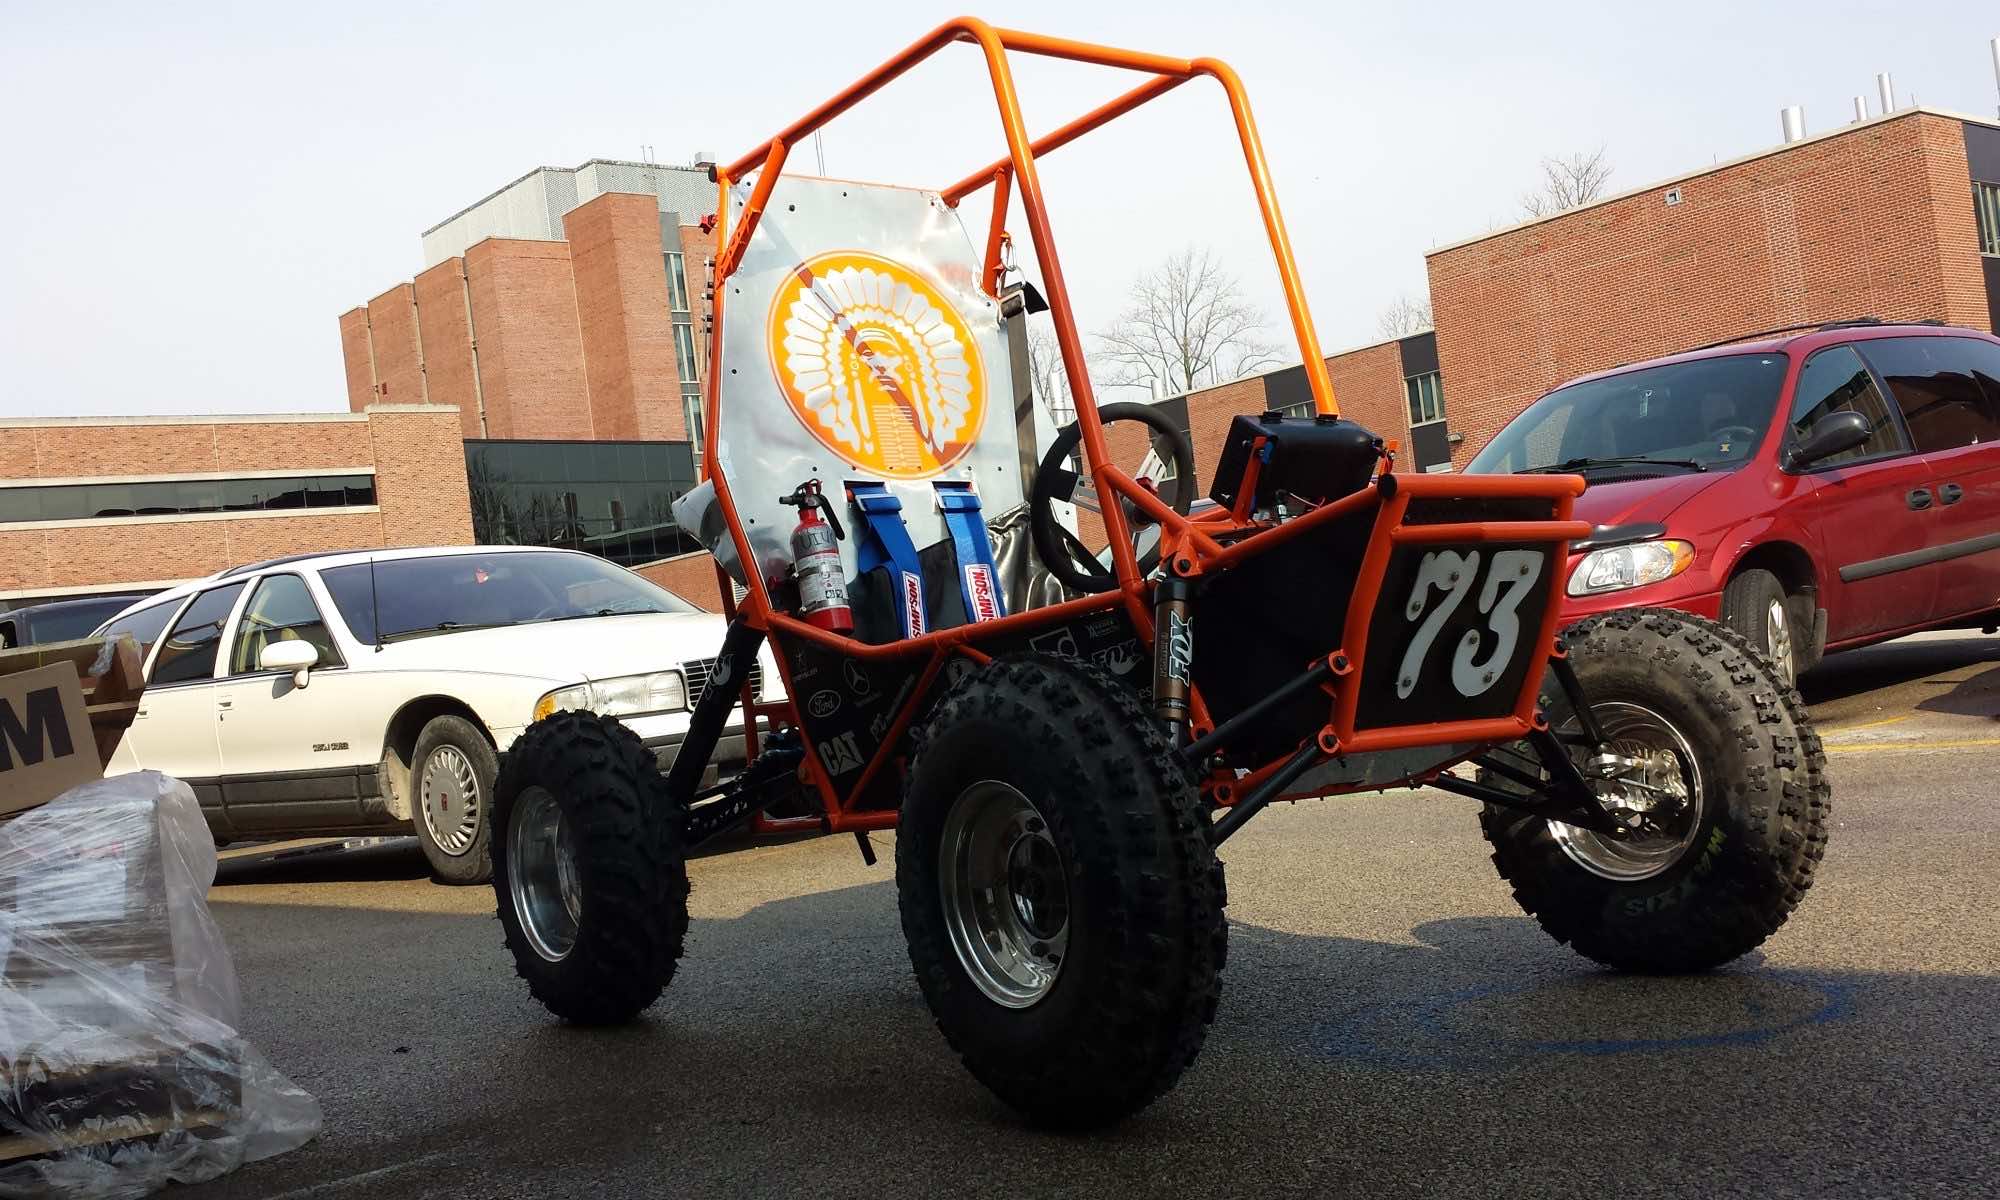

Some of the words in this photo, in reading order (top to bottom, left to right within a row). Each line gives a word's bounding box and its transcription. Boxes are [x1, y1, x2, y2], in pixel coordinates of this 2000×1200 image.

[907, 579, 922, 639] SIMPSON
[1397, 549, 1545, 699] 73
[1169, 609, 1193, 688] FOX
[818, 730, 865, 776] CAT
